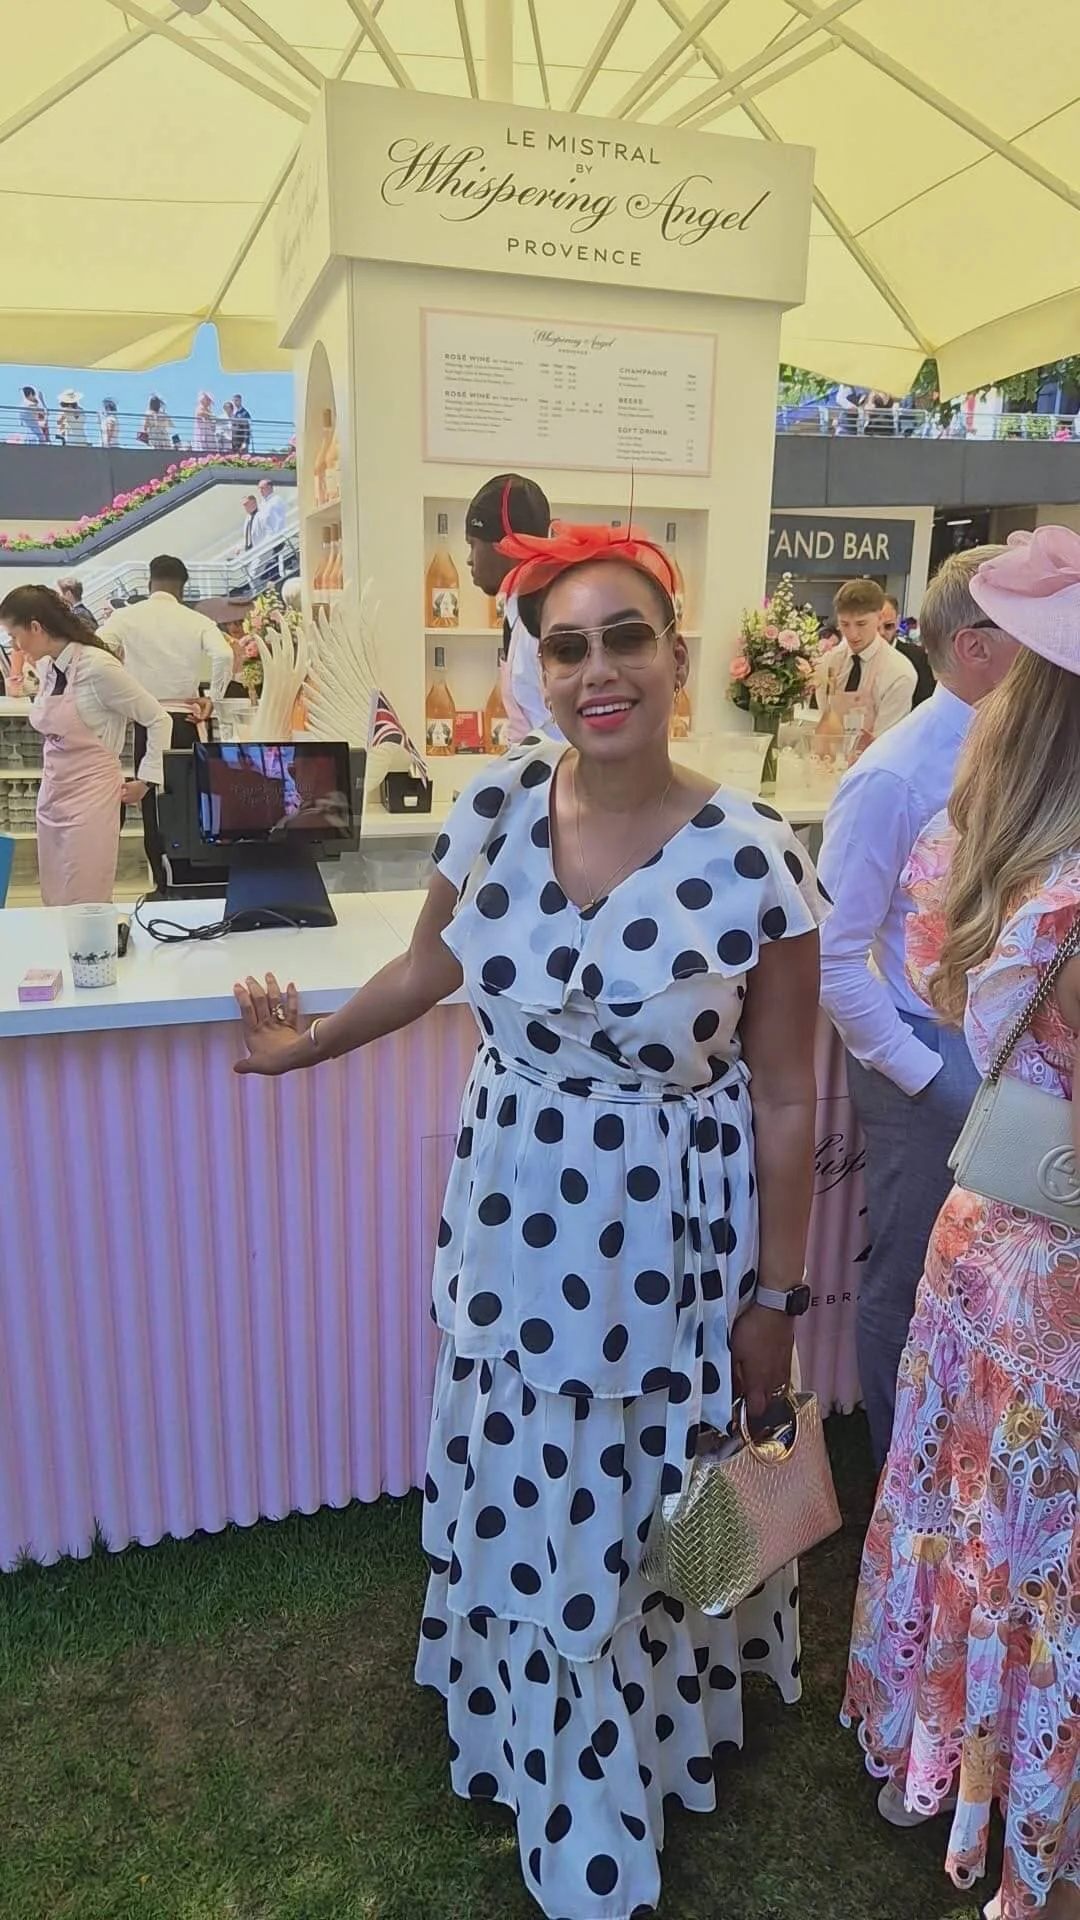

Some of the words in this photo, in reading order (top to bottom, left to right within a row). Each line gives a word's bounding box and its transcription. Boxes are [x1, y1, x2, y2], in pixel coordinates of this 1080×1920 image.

[506, 127, 535, 148] LE
[548, 135, 662, 165] MISTRAL
[575, 163, 593, 175] BY
[381, 138, 617, 233] Whispering
[626, 174, 772, 246] Angel
[507, 237, 642, 267] PROVENCE
[618, 367, 668, 377] CHAMPAGNE
[469, 392, 490, 400] WINE
[617, 426, 637, 434] SOFT
[639, 427, 668, 436] DRINKS
[770, 529, 835, 559] AND
[843, 532, 890, 561] BAR
